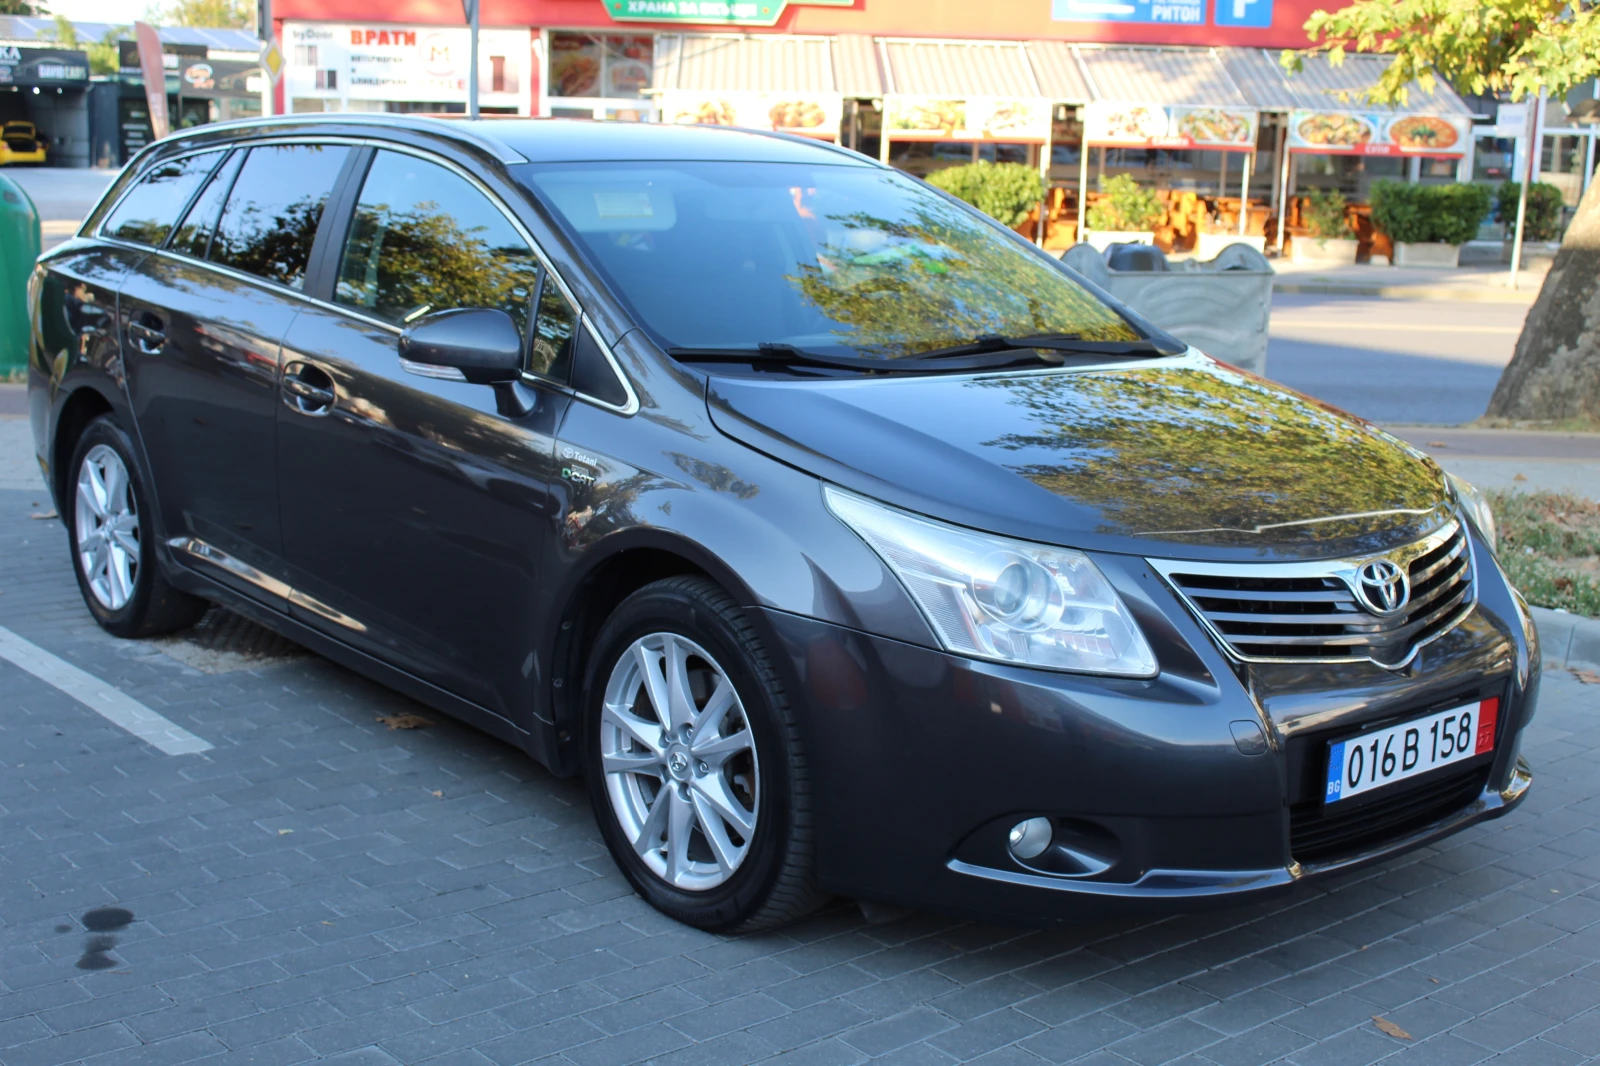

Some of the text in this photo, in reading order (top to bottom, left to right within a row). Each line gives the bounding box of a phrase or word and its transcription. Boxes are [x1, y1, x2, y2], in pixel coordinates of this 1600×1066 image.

[627, 1, 677, 14] ХРАНА
[1152, 5, 1201, 22] РИТОН
[351, 29, 416, 46] ВРАТИ
[1347, 711, 1472, 789] 016 B 158
[1327, 780, 1341, 795] BG
